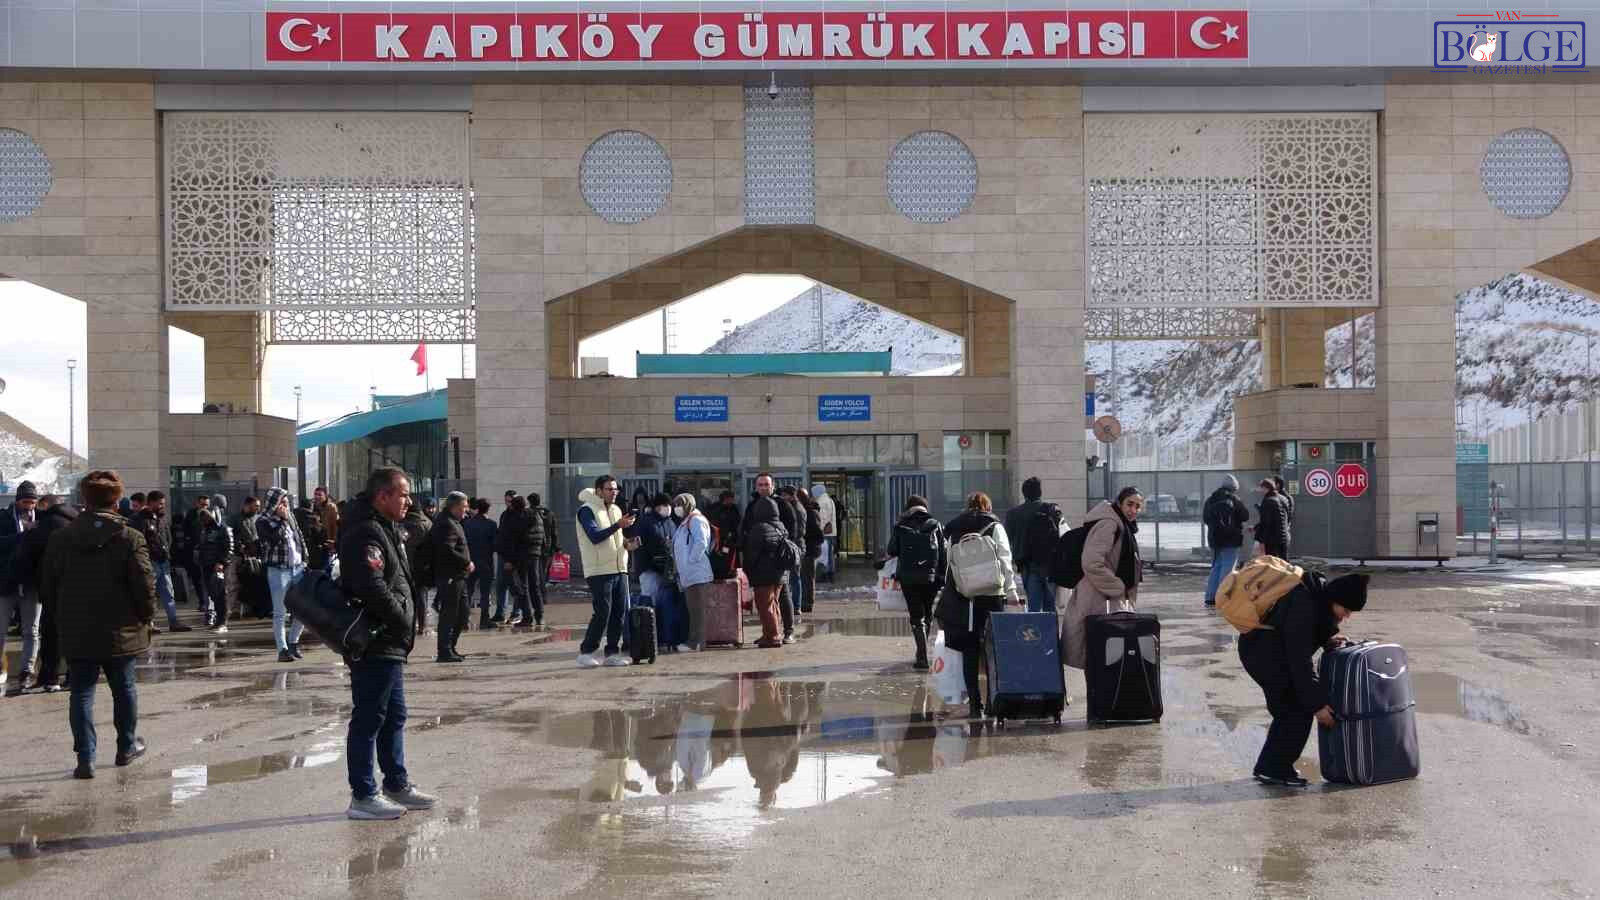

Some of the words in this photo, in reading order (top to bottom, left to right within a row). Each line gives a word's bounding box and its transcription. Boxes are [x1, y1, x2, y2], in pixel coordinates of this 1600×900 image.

[375, 13, 662, 58] KAPIKÖY
[693, 12, 935, 57] GÜMRÜK
[957, 21, 1146, 56] KAPISI
[1311, 477, 1327, 488] 30
[1337, 473, 1366, 489] DUR
